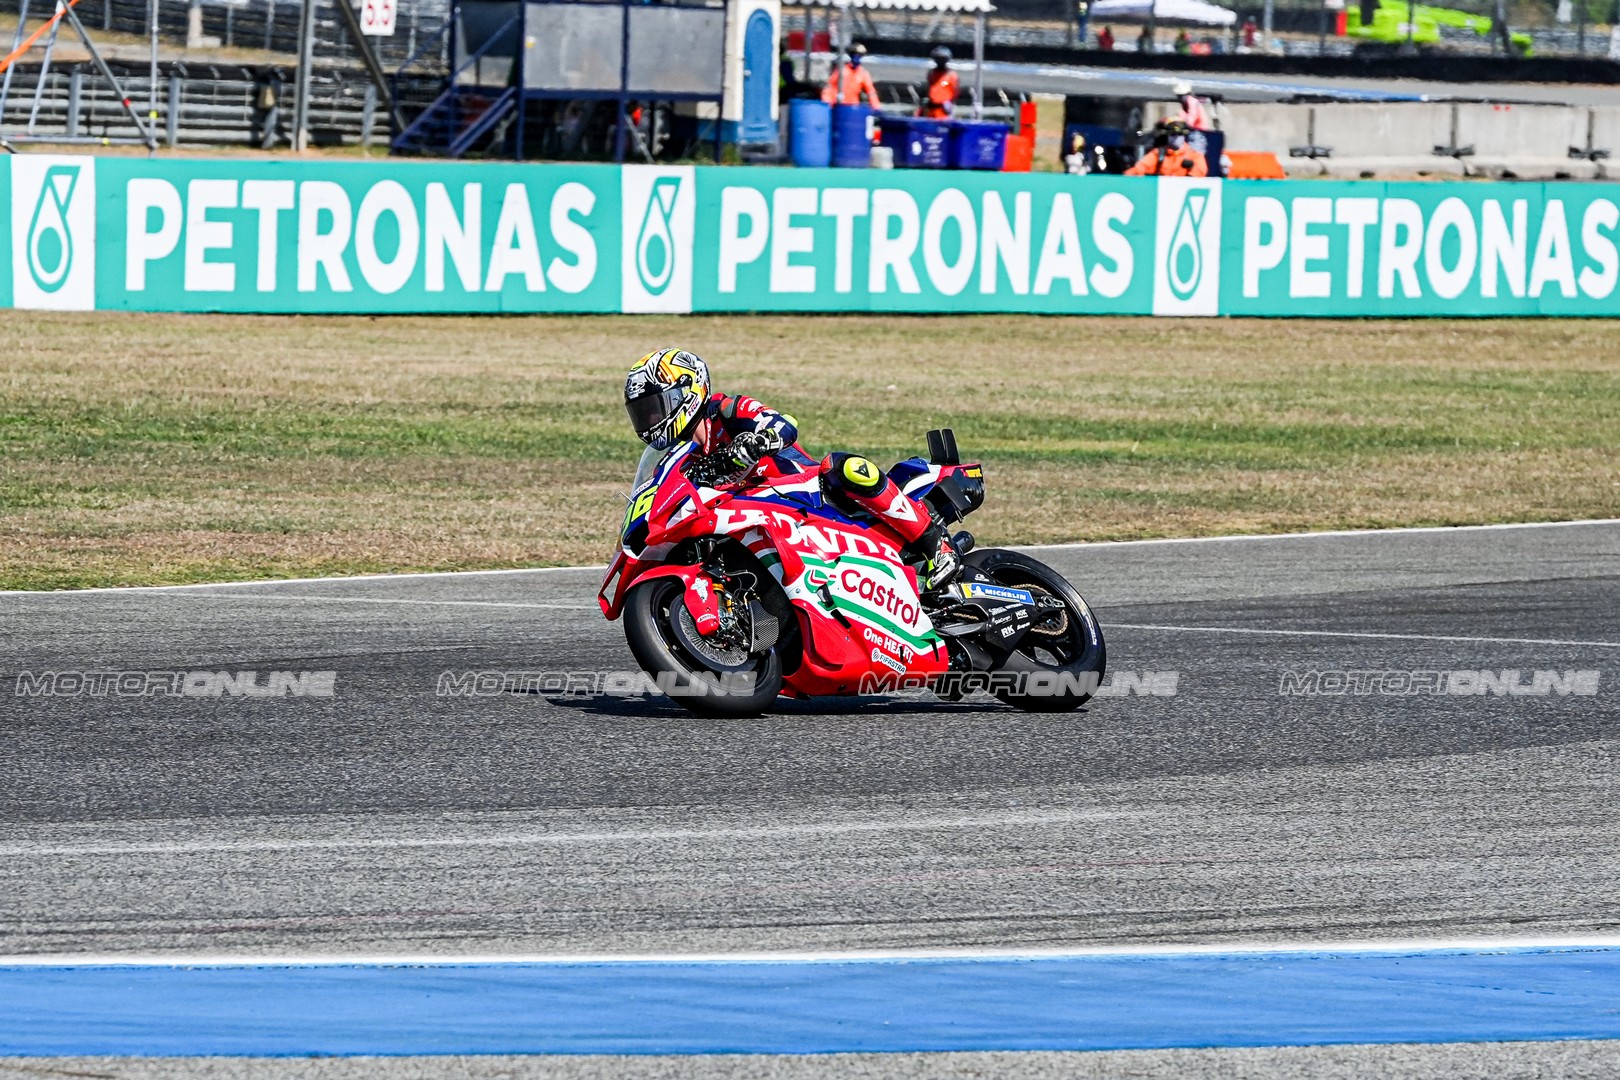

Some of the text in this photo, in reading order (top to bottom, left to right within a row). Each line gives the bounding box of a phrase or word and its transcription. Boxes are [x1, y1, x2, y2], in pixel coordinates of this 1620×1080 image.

[125, 178, 598, 294] PETRONAS
[719, 187, 1135, 298] PETRONAS
[1243, 197, 1620, 298] PETRONAS
[841, 568, 921, 628] Castrol
[985, 588, 1027, 600] MICHELIN
[863, 627, 883, 647] One
[1001, 624, 1015, 638] RK
